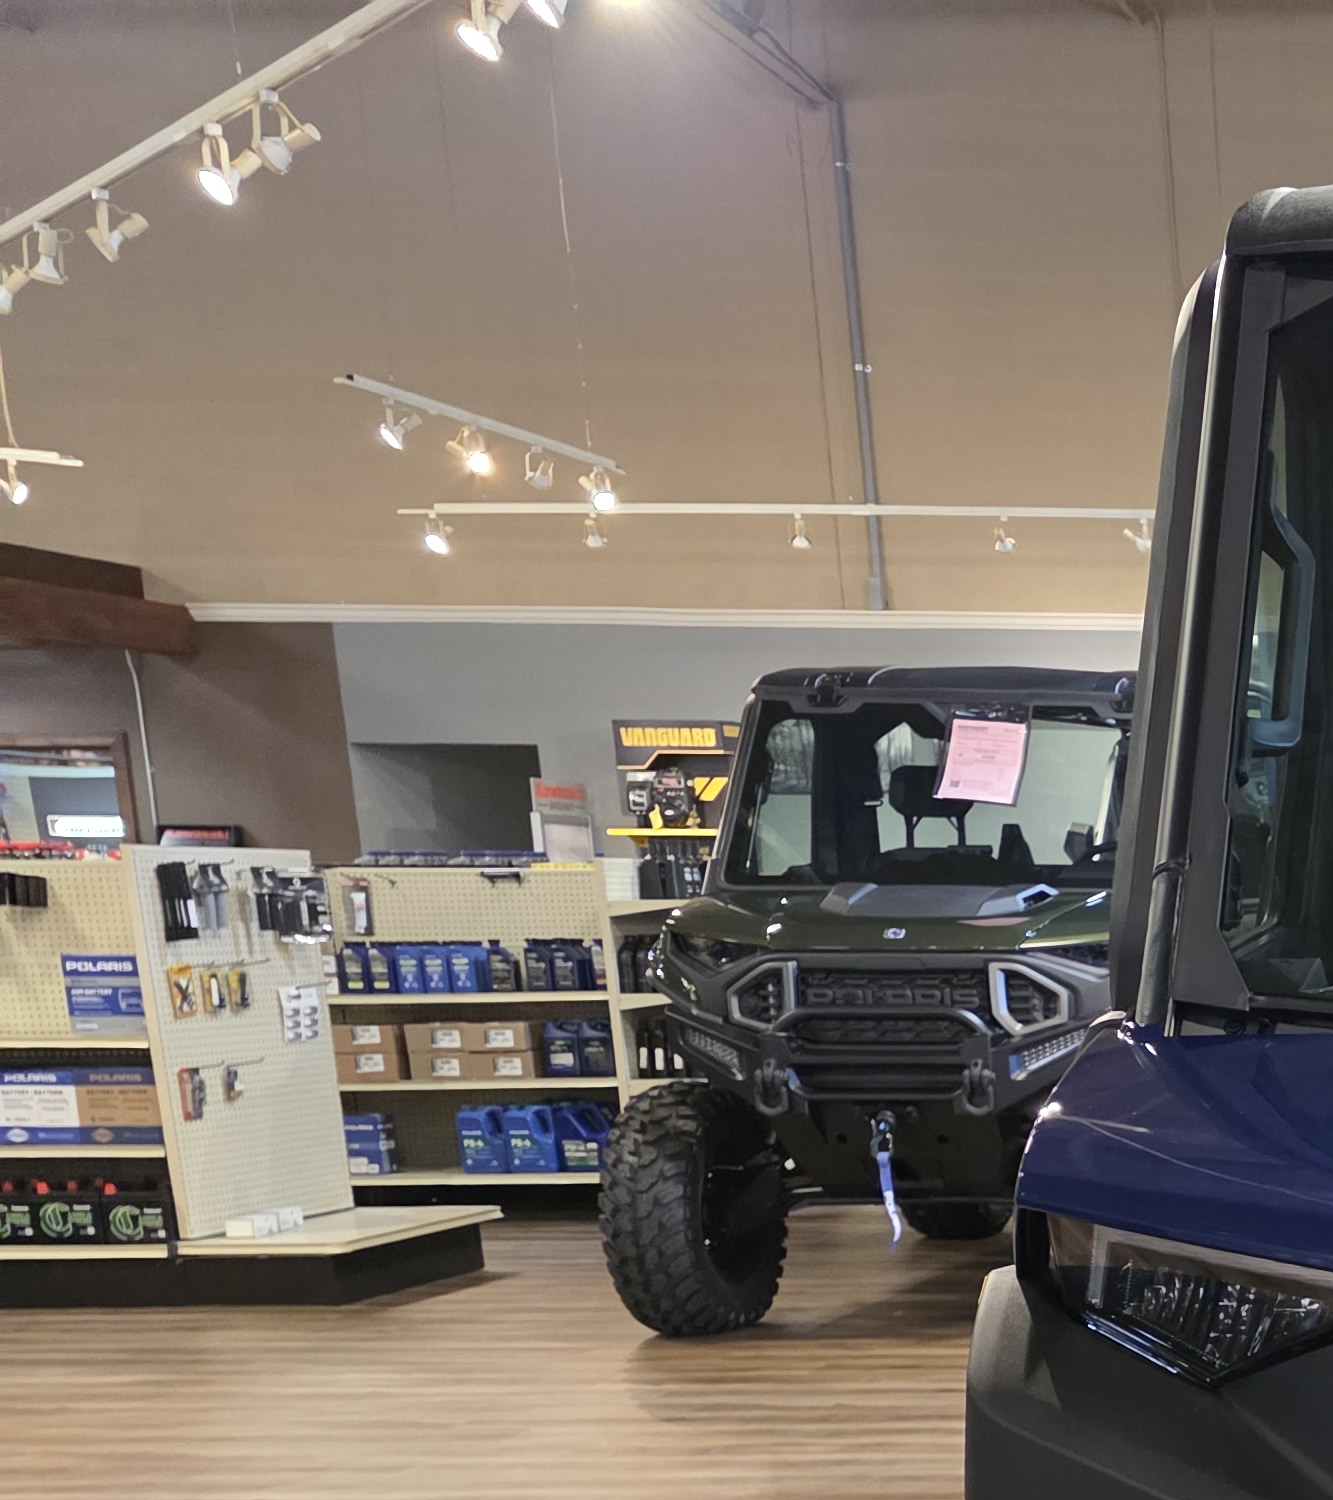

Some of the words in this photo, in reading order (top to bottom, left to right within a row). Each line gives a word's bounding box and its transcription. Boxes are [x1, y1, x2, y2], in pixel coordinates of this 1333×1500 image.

[619, 727, 717, 747] VANGUARD
[66, 961, 133, 972] POLARIS
[4, 1072, 57, 1083] POLARIS
